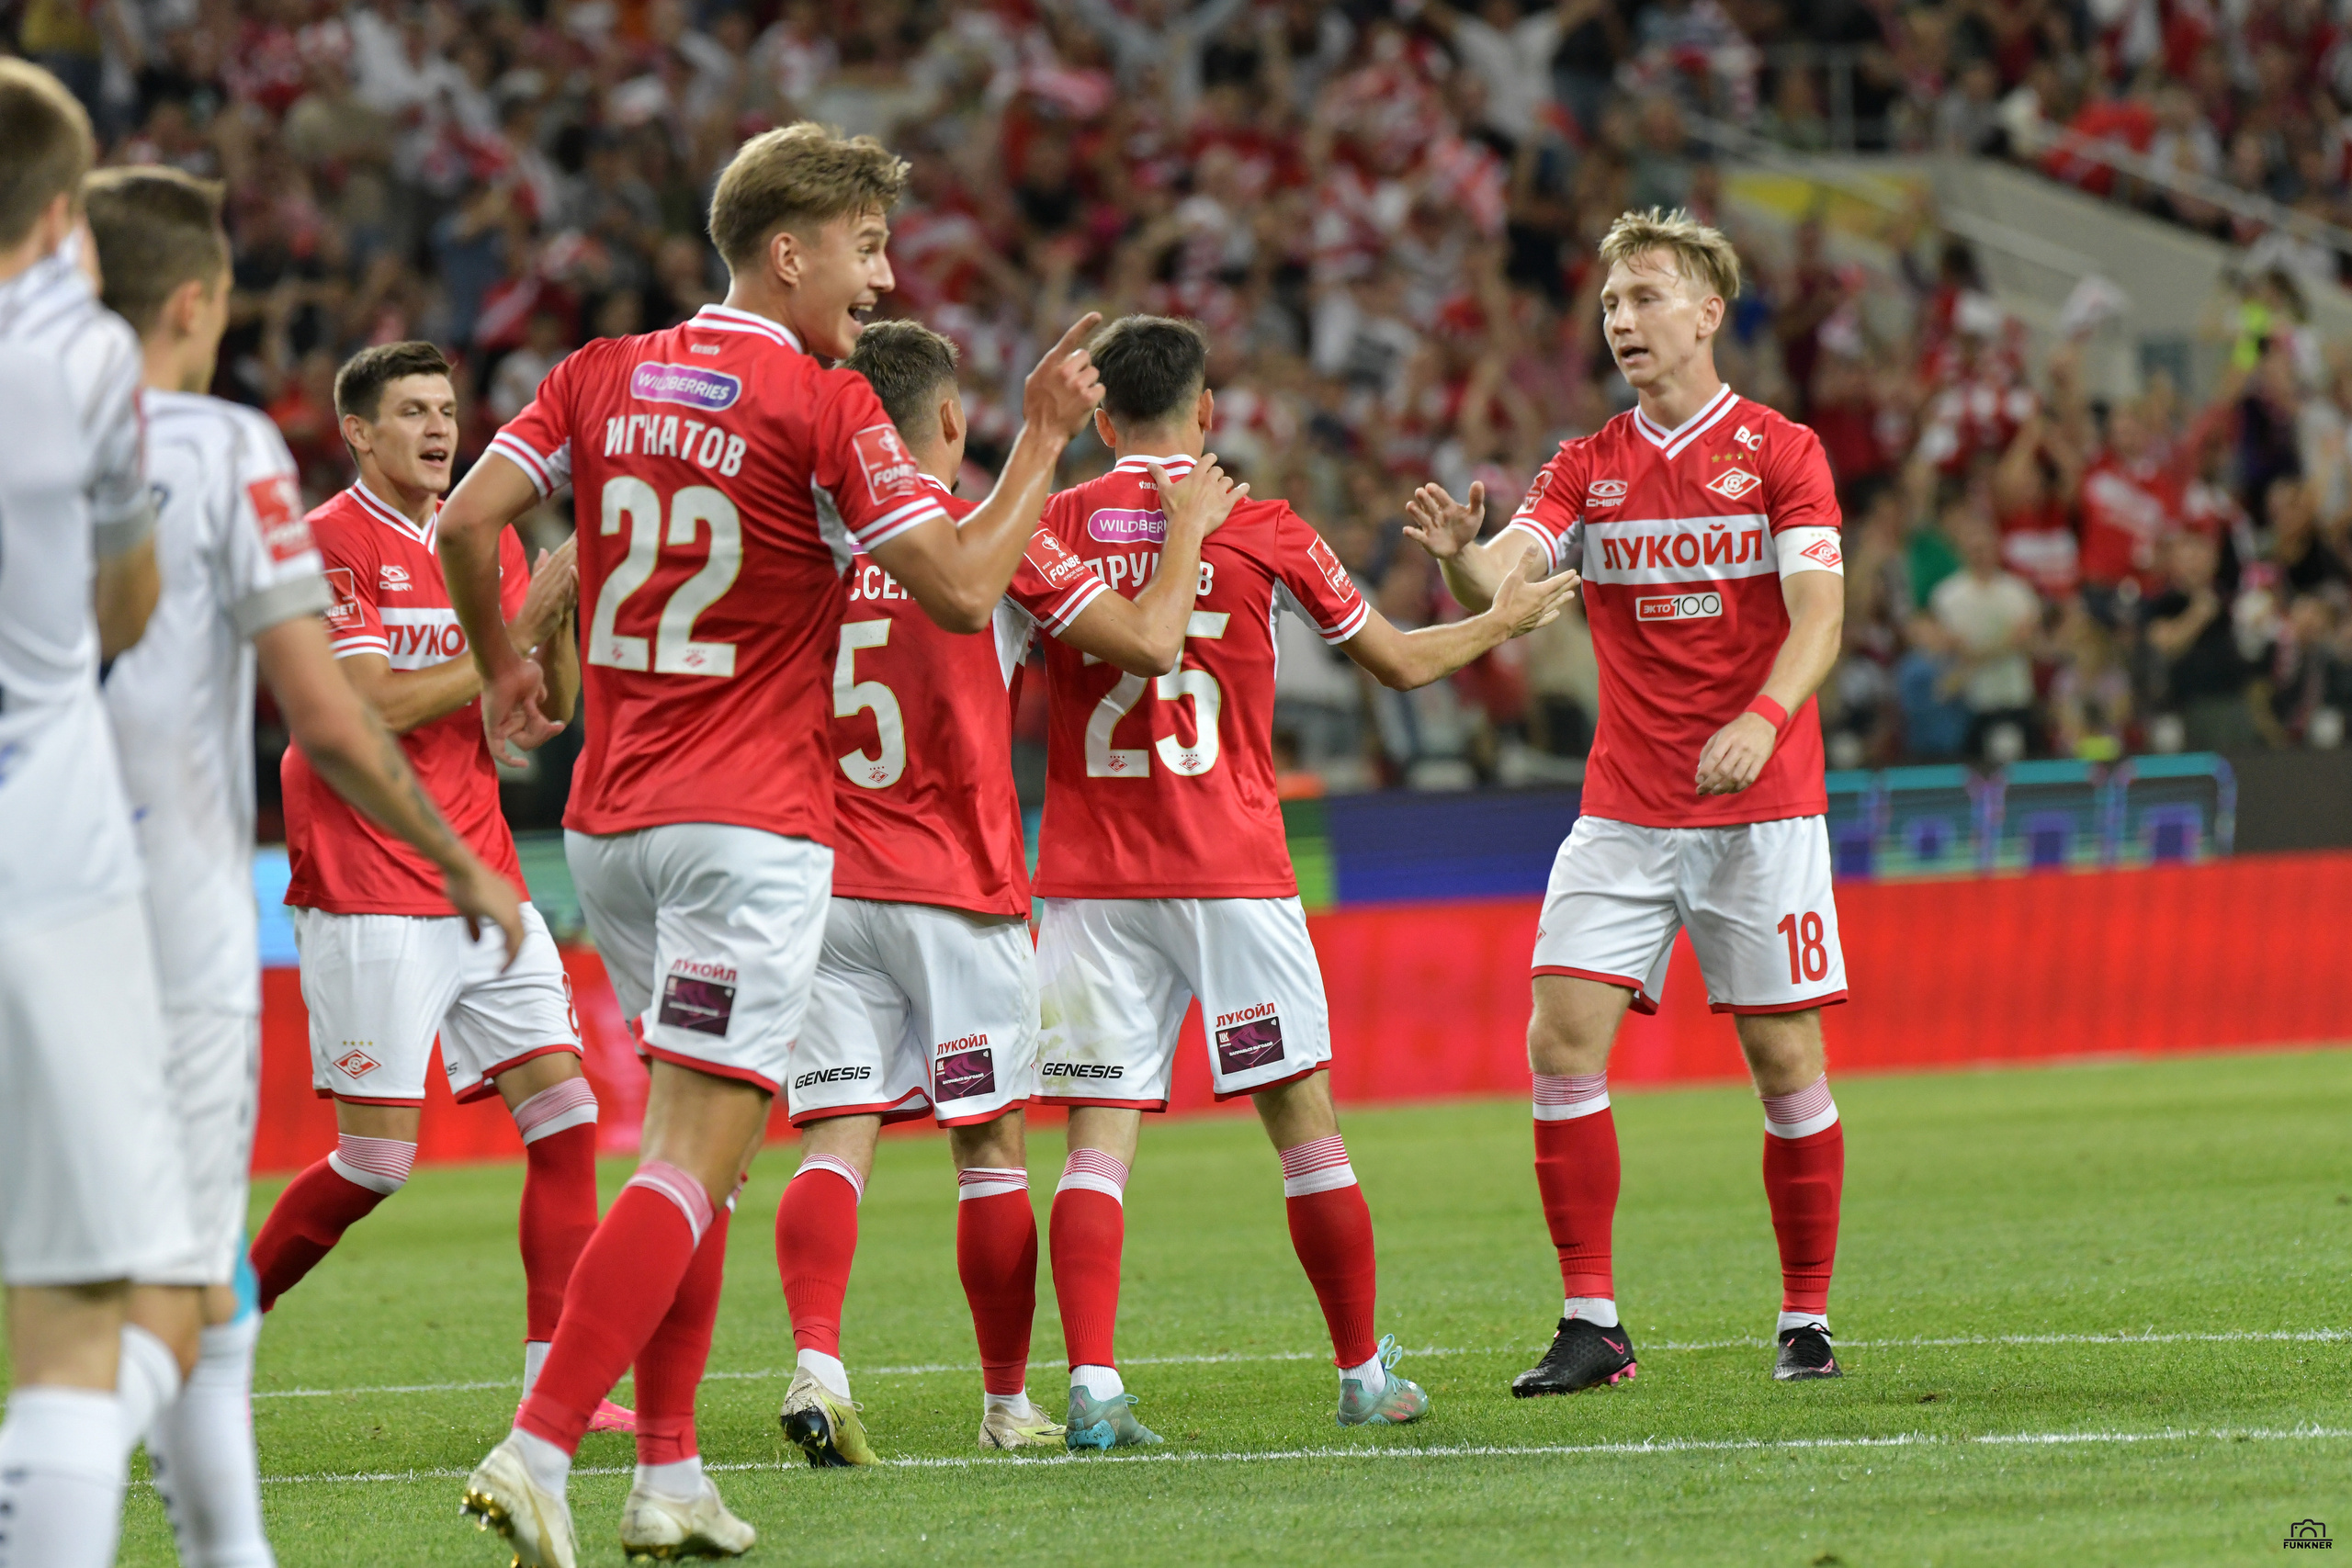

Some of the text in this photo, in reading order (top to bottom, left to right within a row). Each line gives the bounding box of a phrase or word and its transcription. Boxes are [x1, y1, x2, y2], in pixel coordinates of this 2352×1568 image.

[638, 372, 731, 400] WILDBERRIES
[604, 413, 747, 478] ИГНАТОВ
[1100, 519, 1167, 534] WILDBER
[1601, 524, 1762, 570] ЛУКОЙЛ
[588, 476, 743, 678] 22
[1049, 554, 1081, 581] FONBE
[384, 624, 467, 657] ЛУКО
[832, 618, 906, 789] 5
[1082, 610, 1231, 778] 25
[1777, 911, 1828, 986] 18
[672, 959, 738, 984] ЛУКОЙЛ
[1216, 1002, 1275, 1027] ЛУКОЙЛ
[936, 1033, 989, 1055] ЛУКОЙЛ
[795, 1066, 872, 1089] GENESIS
[1042, 1062, 1125, 1079] GENESIS
